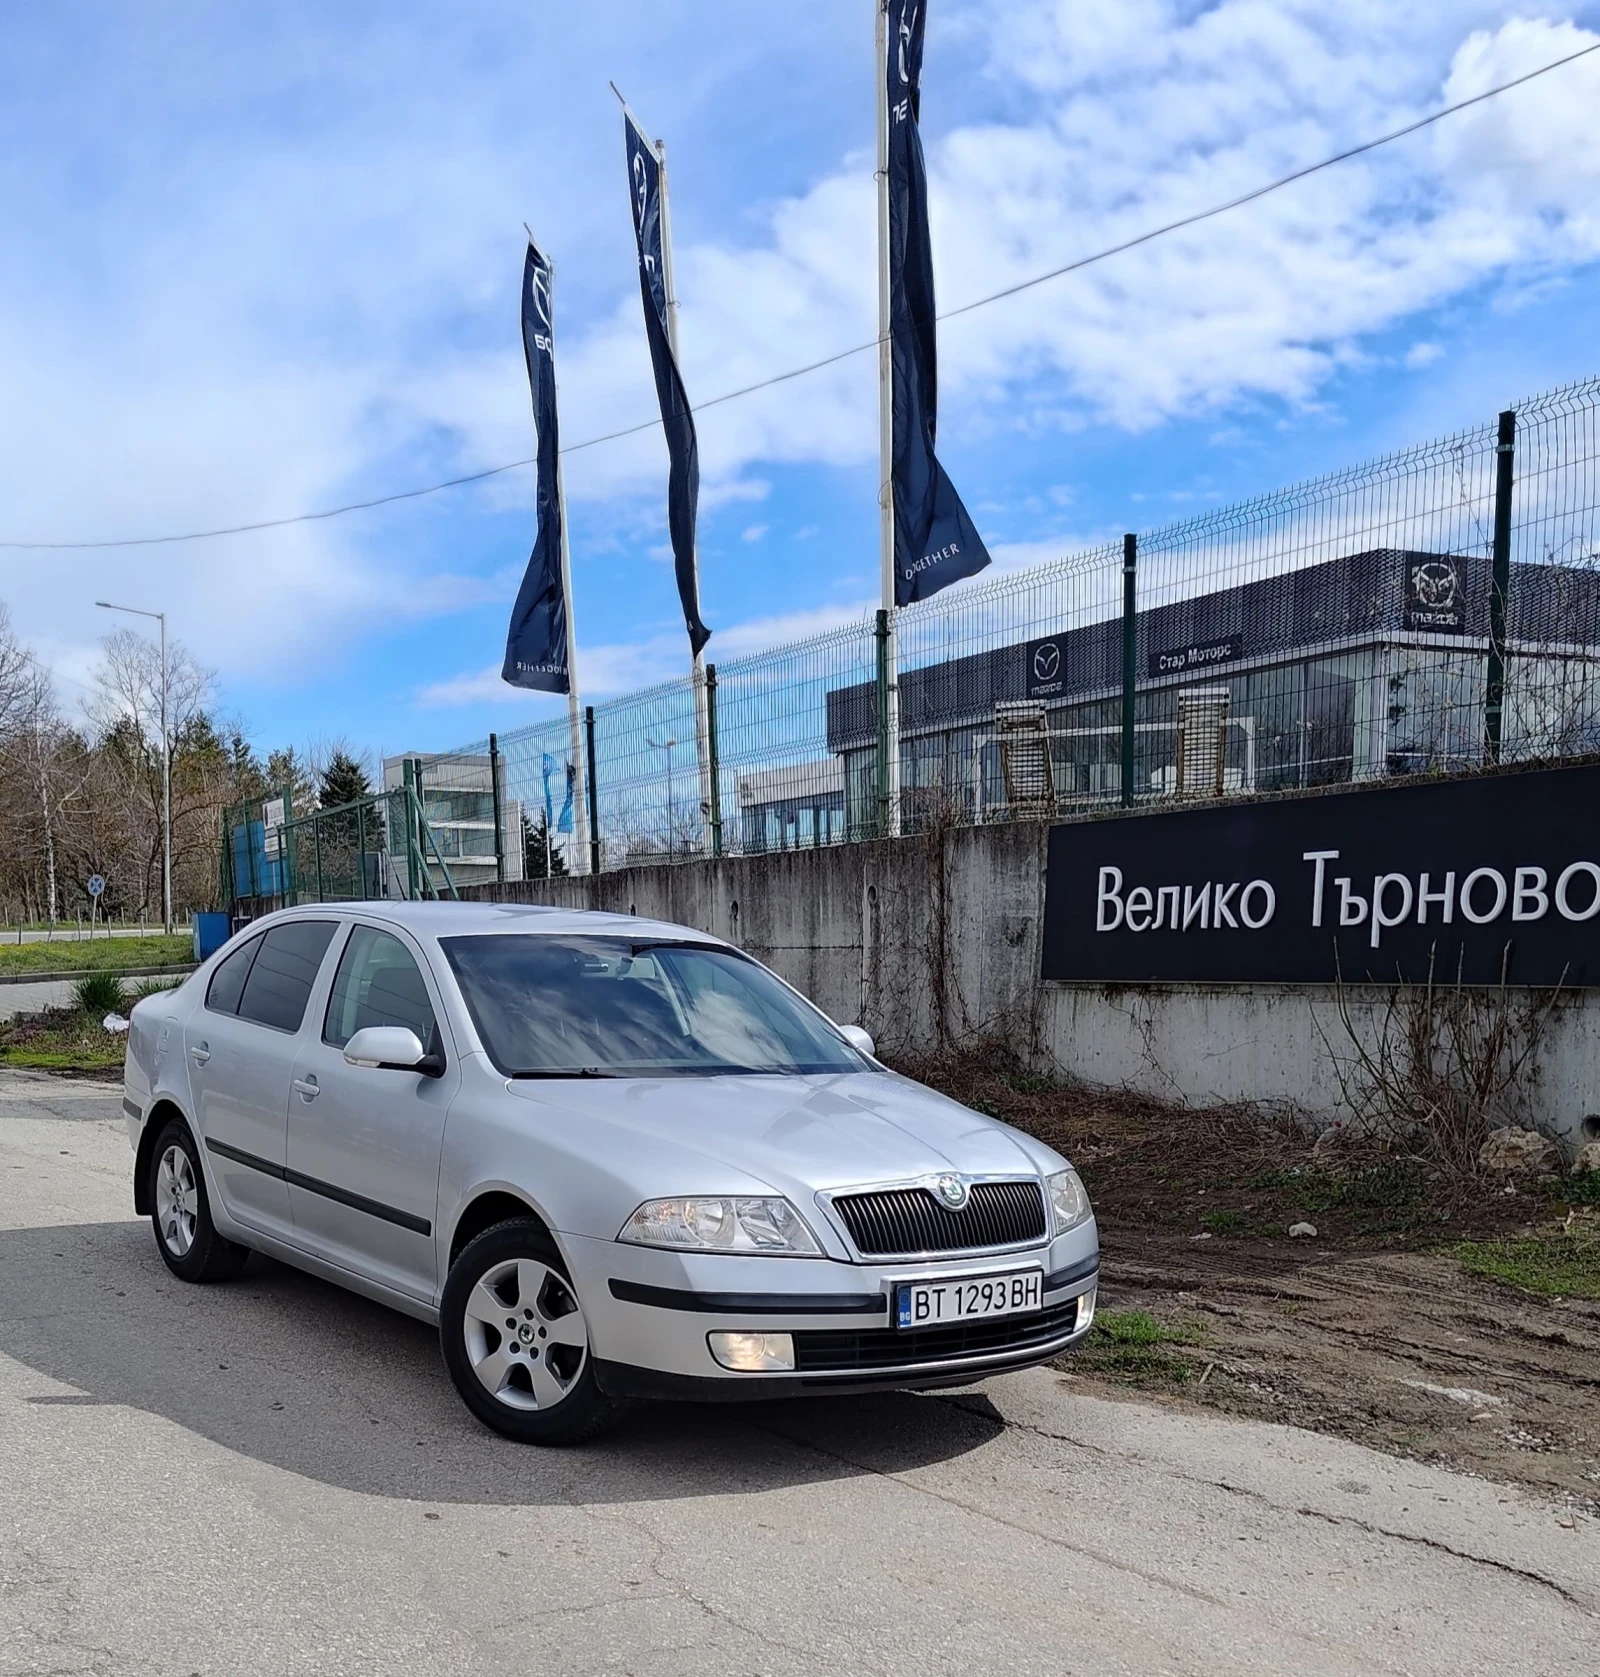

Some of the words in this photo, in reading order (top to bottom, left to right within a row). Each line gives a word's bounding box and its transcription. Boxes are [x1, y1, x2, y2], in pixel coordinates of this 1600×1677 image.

[1159, 654, 1185, 670] Стар
[1188, 643, 1232, 664] Моторс
[1031, 681, 1062, 696] mazda
[1096, 865, 1276, 933] Велико
[1302, 849, 1600, 949] Търново
[915, 1288, 946, 1320] BT
[955, 1281, 1006, 1316] 1293
[1011, 1276, 1038, 1308] BH
[899, 1311, 911, 1322] BG
